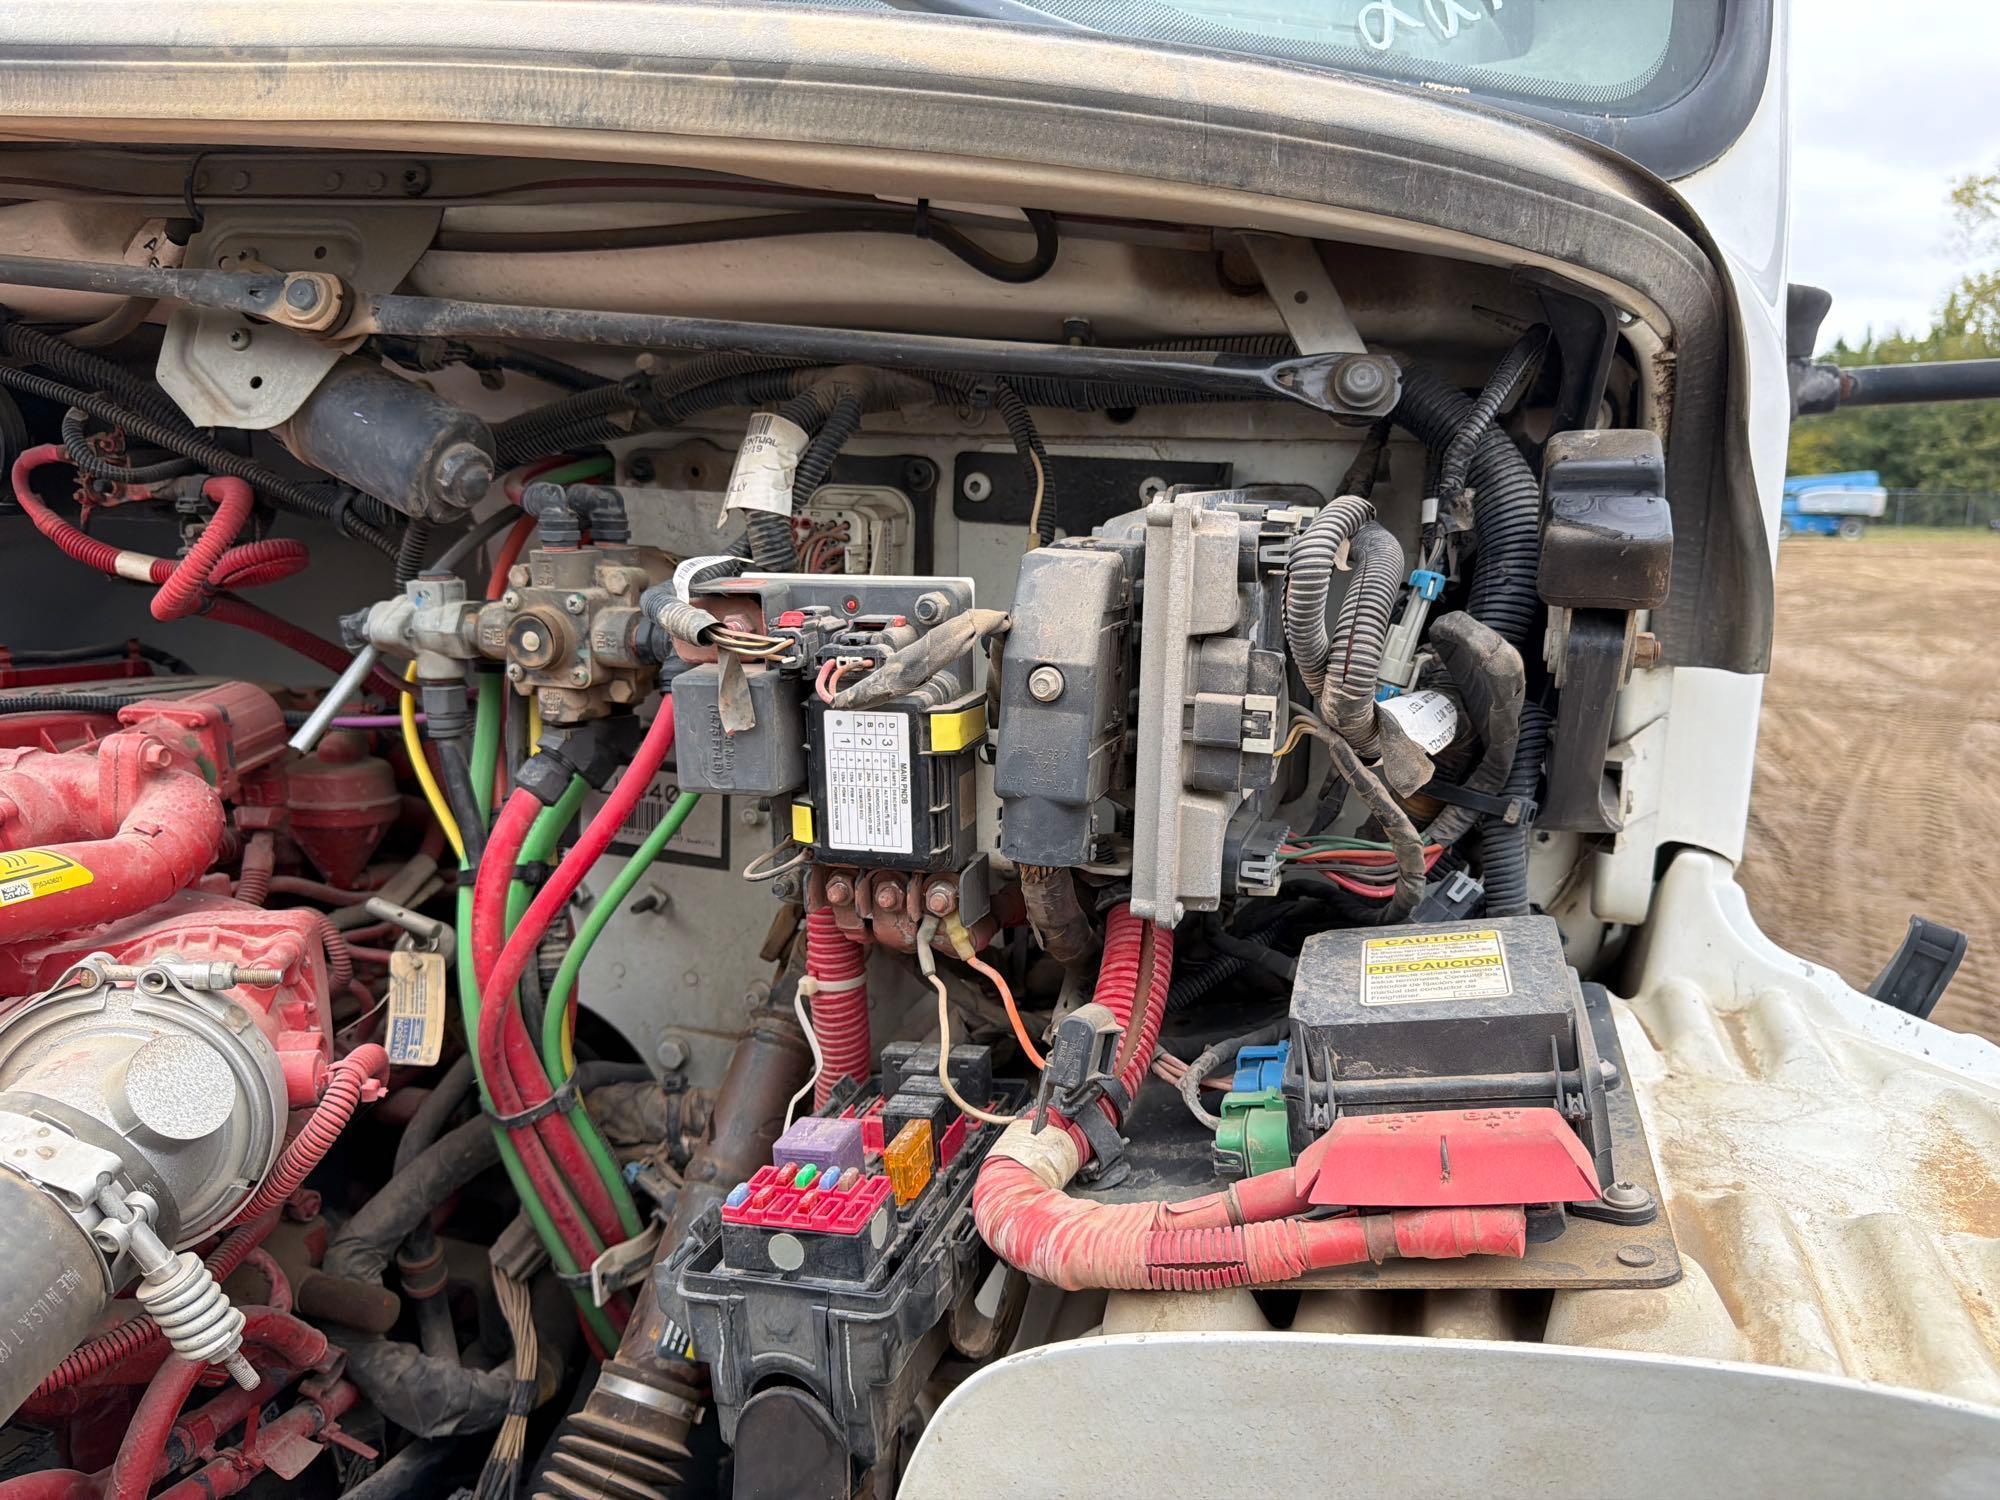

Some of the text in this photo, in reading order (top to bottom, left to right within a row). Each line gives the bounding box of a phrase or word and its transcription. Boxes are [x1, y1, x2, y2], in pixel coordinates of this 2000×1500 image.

[1385, 933, 1480, 945] CAUTION
[1367, 1113, 1424, 1125] BAT
[1463, 1110, 1521, 1122] BAT
[45, 1286, 63, 1304] IN
